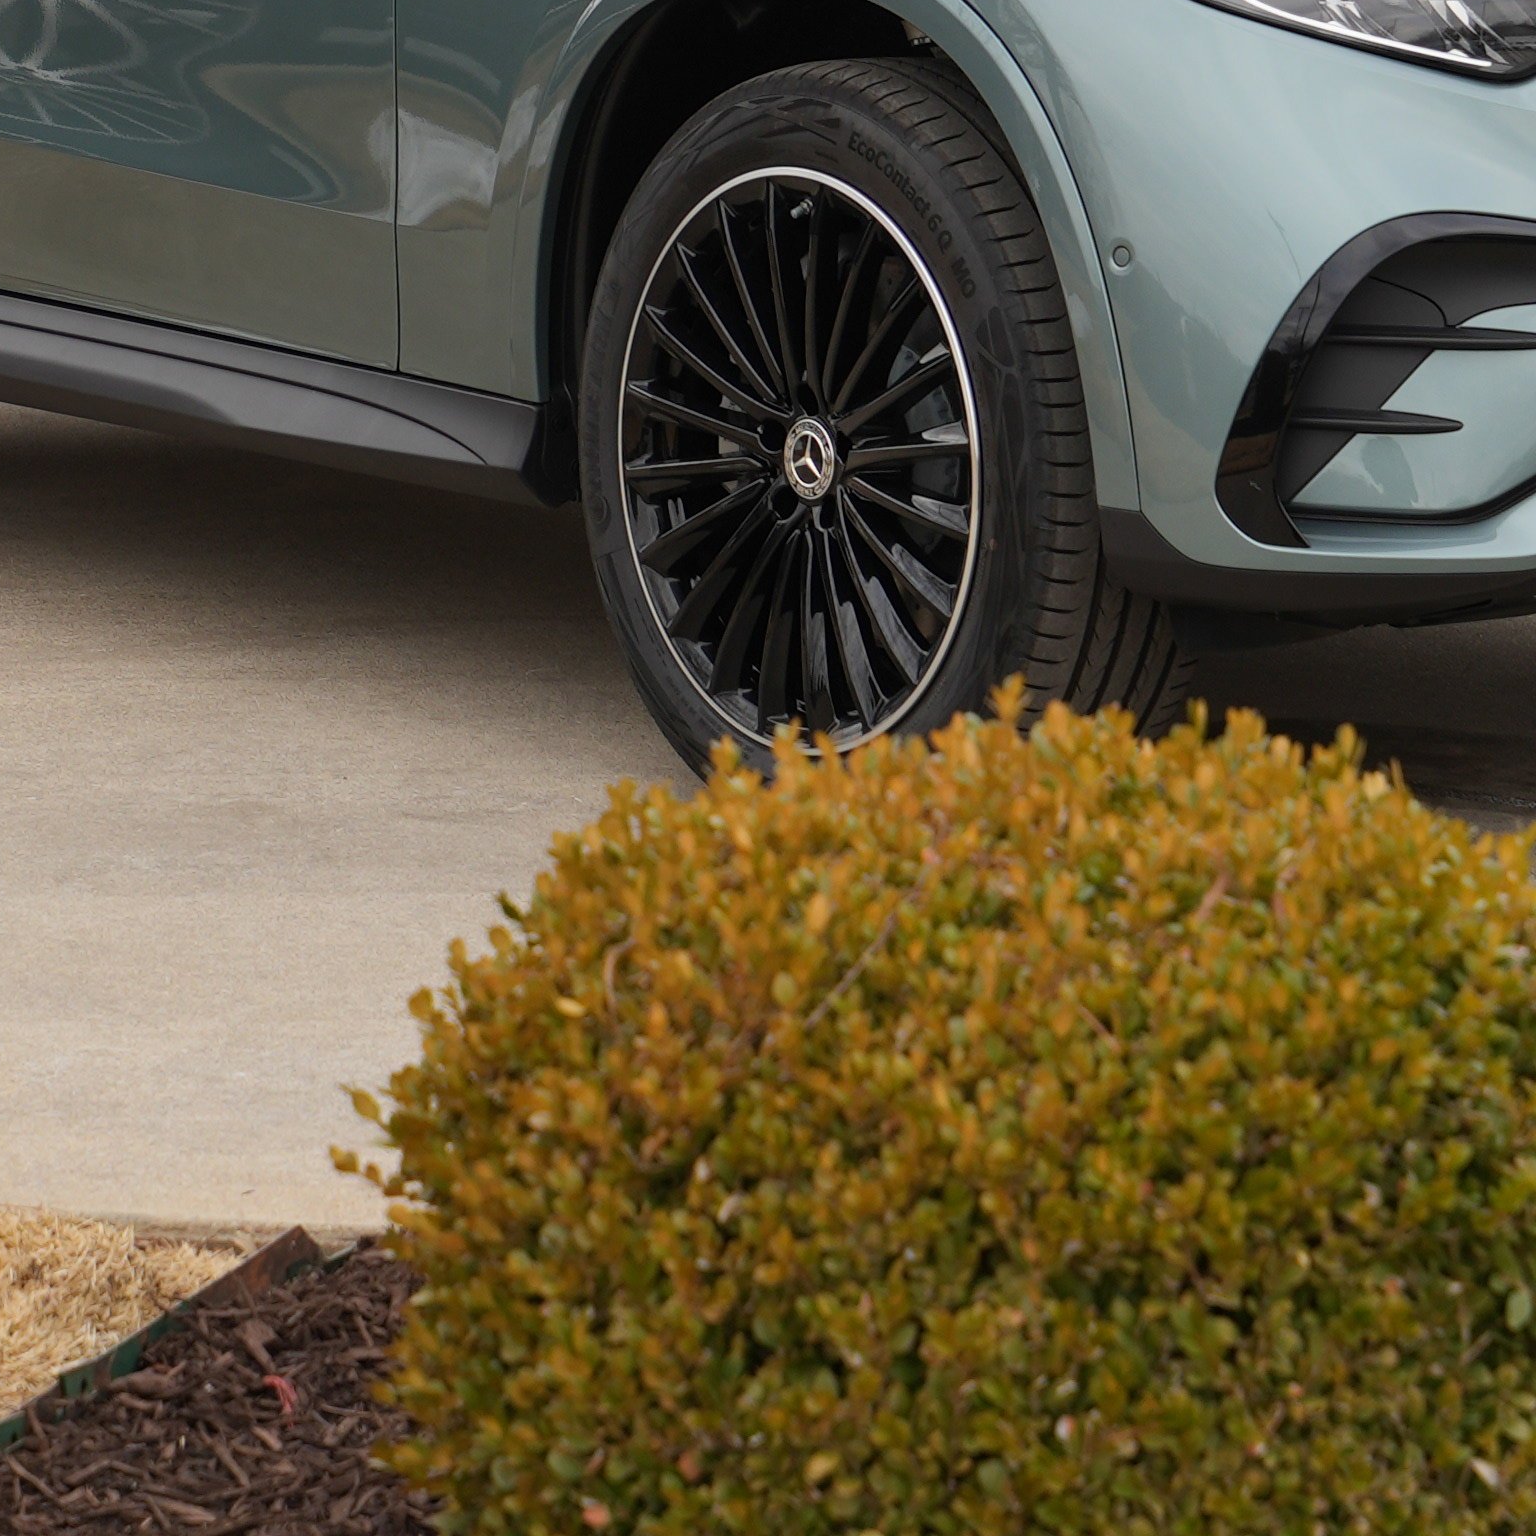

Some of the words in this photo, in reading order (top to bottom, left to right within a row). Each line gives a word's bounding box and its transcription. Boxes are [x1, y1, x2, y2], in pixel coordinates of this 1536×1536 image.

[847, 132, 932, 219] EcoContact
[927, 214, 943, 233] 6
[937, 231, 953, 255] Q
